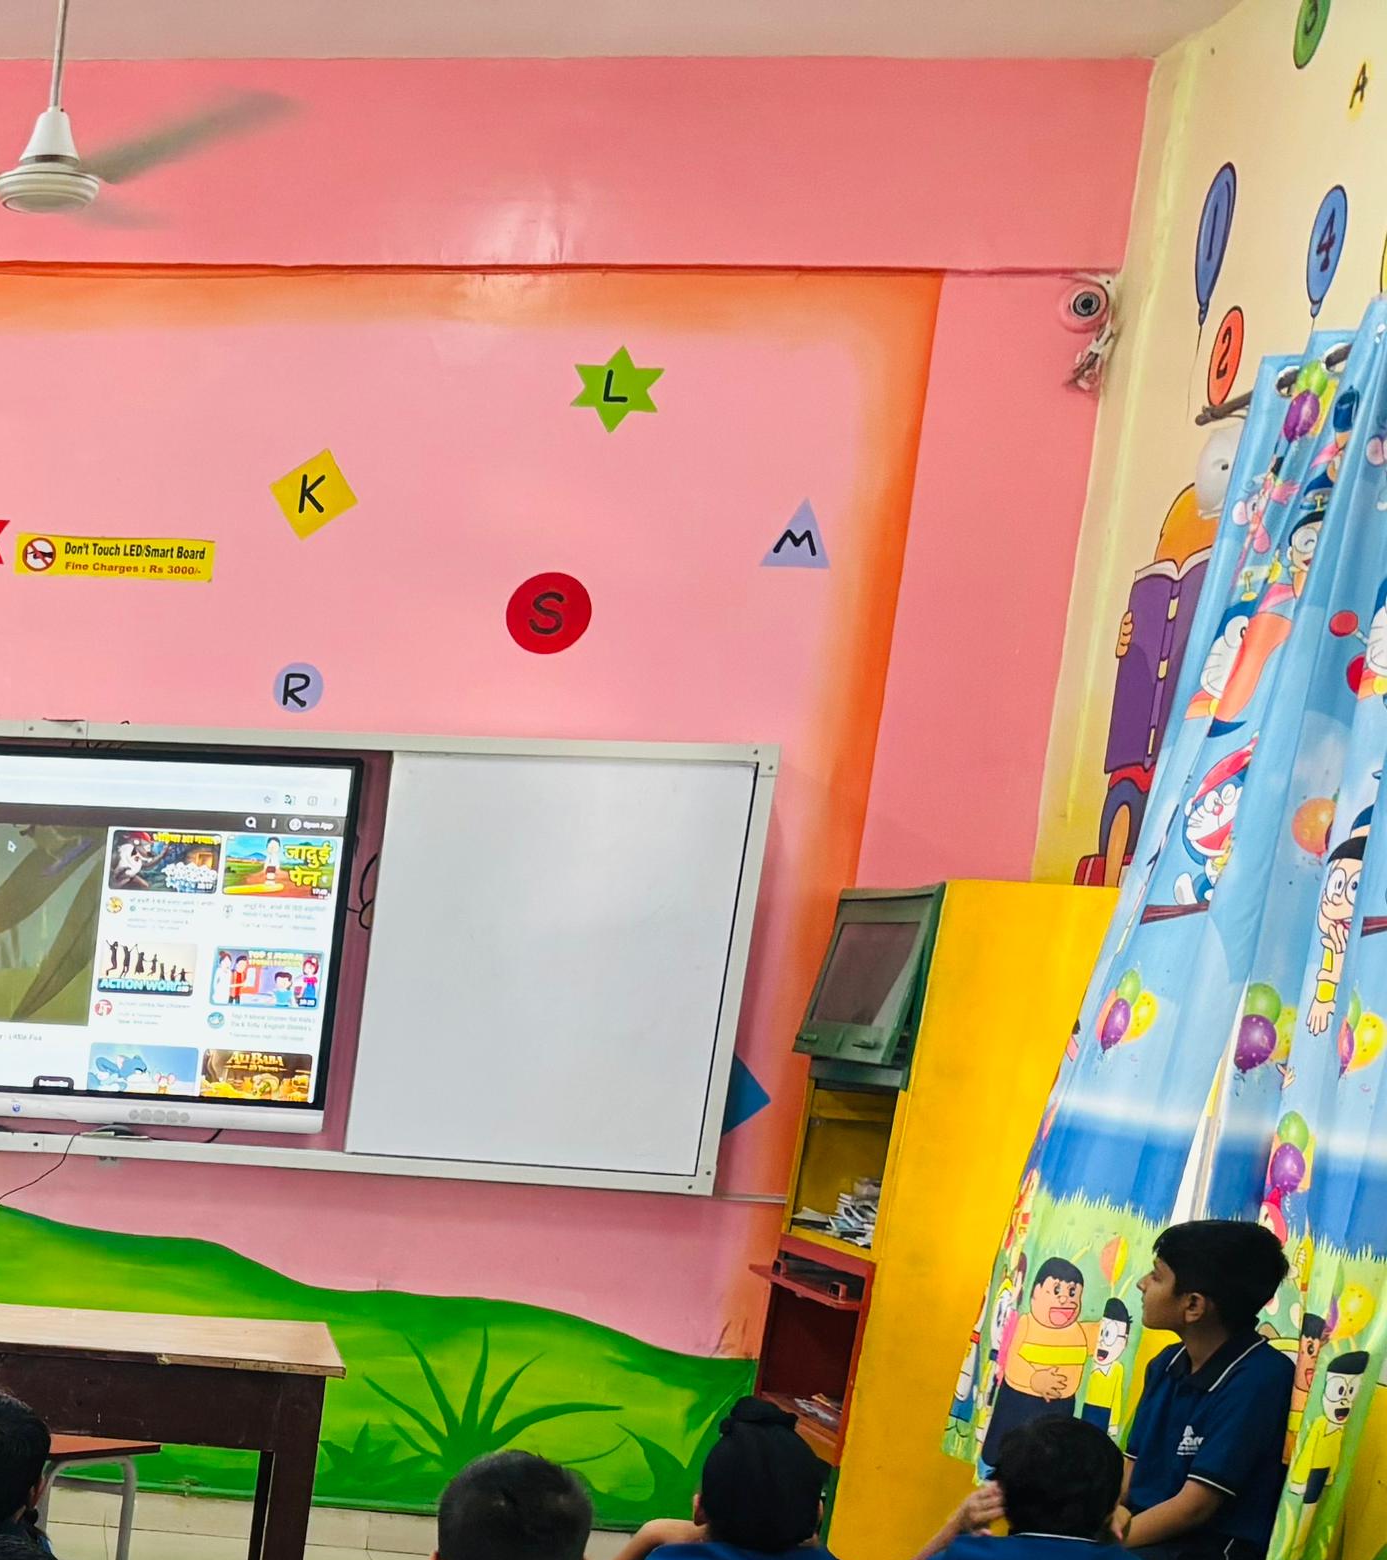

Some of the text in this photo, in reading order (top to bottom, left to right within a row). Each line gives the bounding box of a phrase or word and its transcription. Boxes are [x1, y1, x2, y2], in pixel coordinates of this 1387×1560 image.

[1216, 326, 1232, 379] 2
[603, 370, 627, 402] L
[297, 474, 326, 514] K
[65, 542, 206, 560] Don't Touch LED/Smart Board
[773, 529, 817, 556] M
[65, 561, 89, 570] Fine
[92, 562, 139, 574] Charges
[149, 565, 163, 574] Rs
[167, 566, 201, 575] 3000/-
[528, 591, 565, 635] S
[282, 672, 310, 707] R
[284, 840, 333, 868] जादुई
[288, 865, 321, 888] पेन
[99, 978, 143, 990] ACTION
